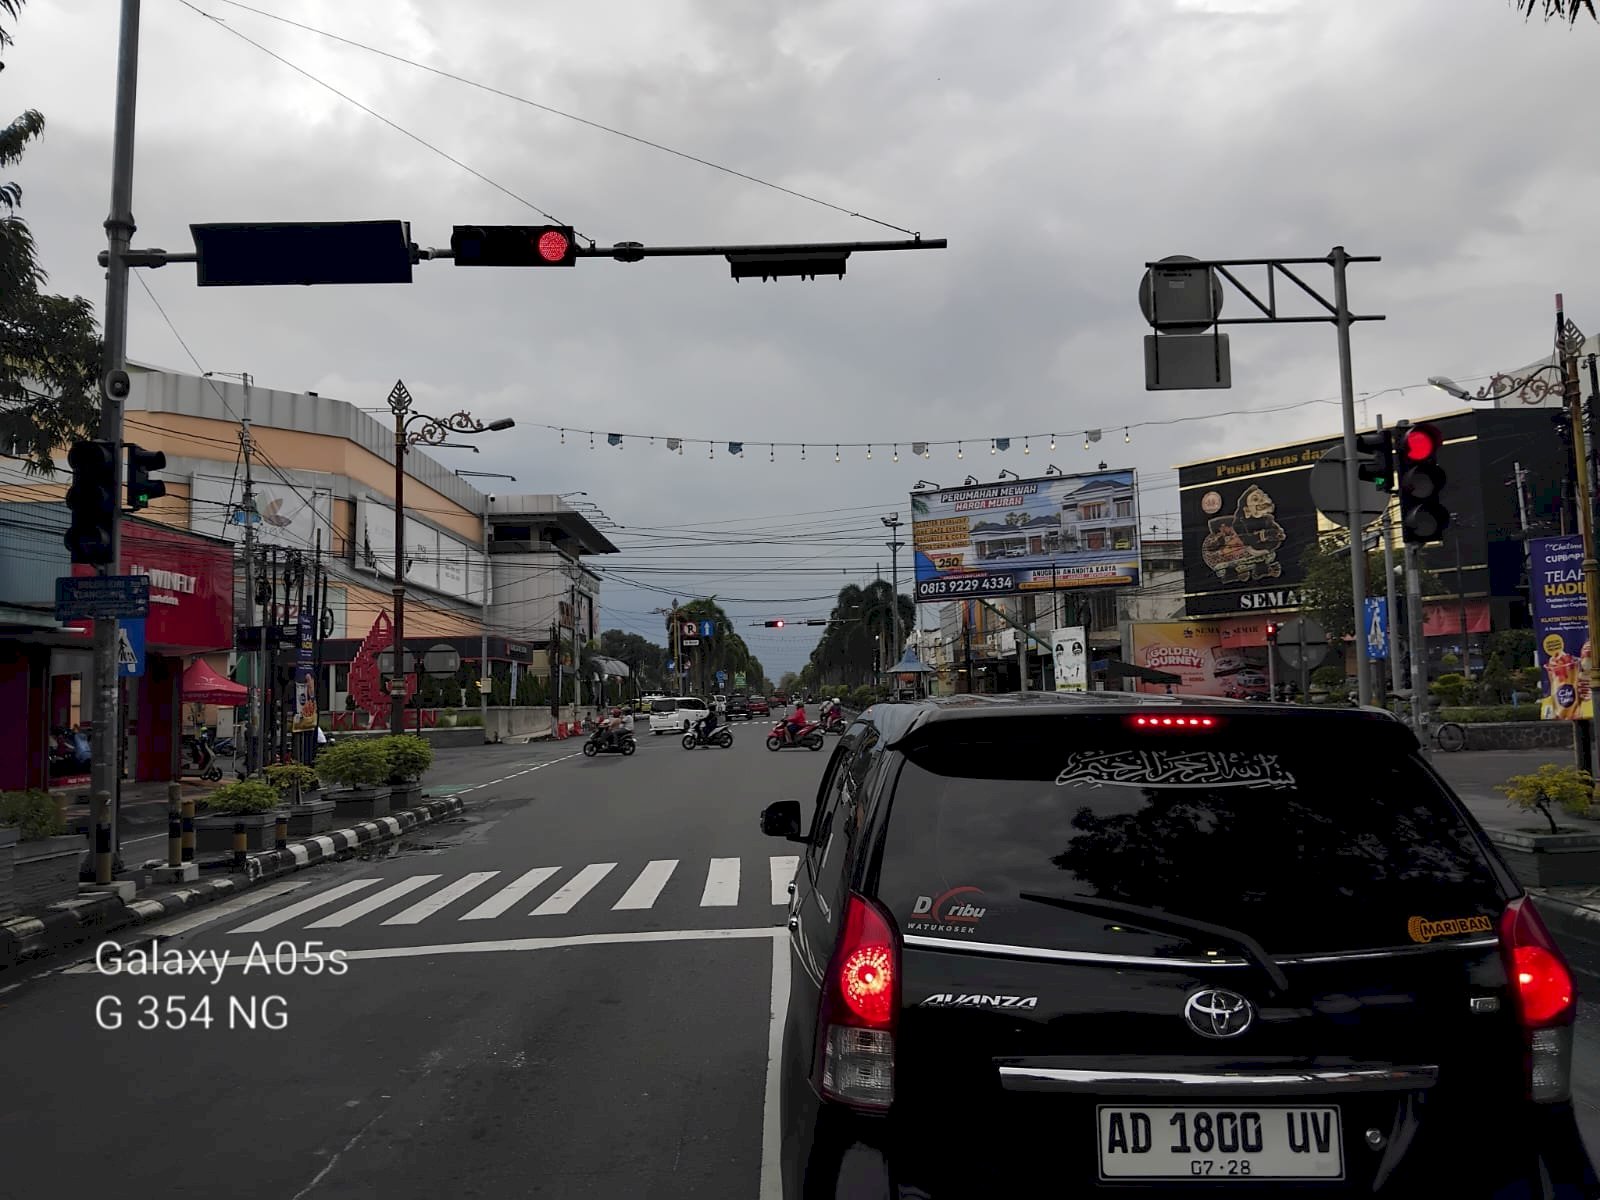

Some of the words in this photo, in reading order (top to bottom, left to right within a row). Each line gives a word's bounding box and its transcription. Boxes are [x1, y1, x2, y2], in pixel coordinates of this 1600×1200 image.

[1216, 461, 1257, 477] Pusat
[1259, 454, 1299, 470] Emas
[942, 489, 999, 503] PERUMAHAN
[1000, 485, 1037, 496] MEWAH
[955, 500, 986, 511] HARGA
[988, 496, 1023, 508] MURAH
[939, 557, 959, 568] 250
[1033, 569, 1060, 577] ANUGRH
[920, 581, 946, 594] 0813
[949, 579, 979, 592] 9229
[982, 576, 1013, 590] 4334
[1150, 647, 1198, 658] GOLDEN
[1145, 656, 1204, 668] JOURNEY!
[332, 710, 436, 730] KLAEN
[907, 923, 975, 934] WATUKOSEK
[919, 993, 1038, 1008] AVANZA
[1108, 1111, 1152, 1154] AD
[1169, 1111, 1264, 1154] 1800
[1287, 1111, 1332, 1153] UV
